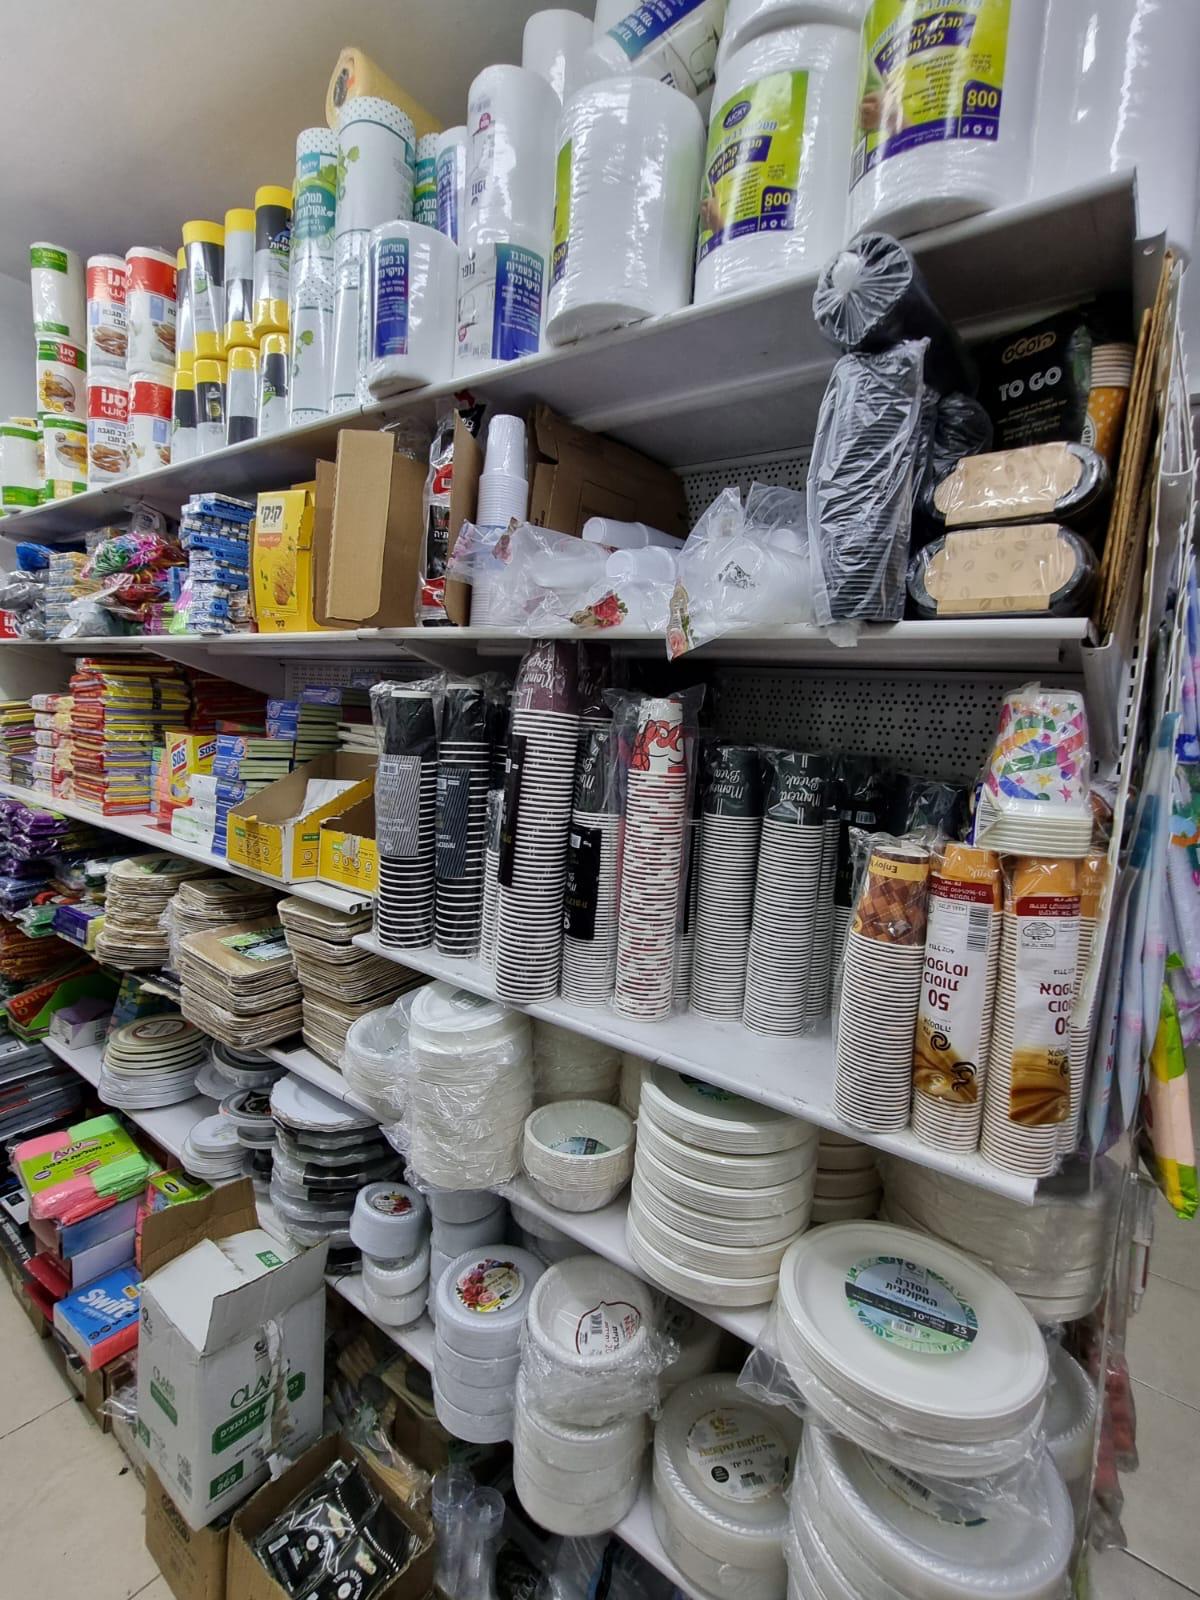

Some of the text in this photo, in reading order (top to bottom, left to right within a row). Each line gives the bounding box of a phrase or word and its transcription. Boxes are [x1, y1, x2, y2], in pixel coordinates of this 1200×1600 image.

[966, 90, 998, 109] 800
[765, 193, 791, 207] 800
[998, 365, 1062, 401] TO GO
[101, 388, 128, 409] סנו
[172, 747, 186, 767] SOS
[199, 743, 217, 757] SOS
[923, 956, 968, 978] ספרסו
[928, 988, 951, 1012] 50
[884, 1282, 939, 1308] האקולוגית
[895, 1277, 930, 1296] הסדרה
[77, 1288, 137, 1319] Swift
[953, 1323, 968, 1335] 25
